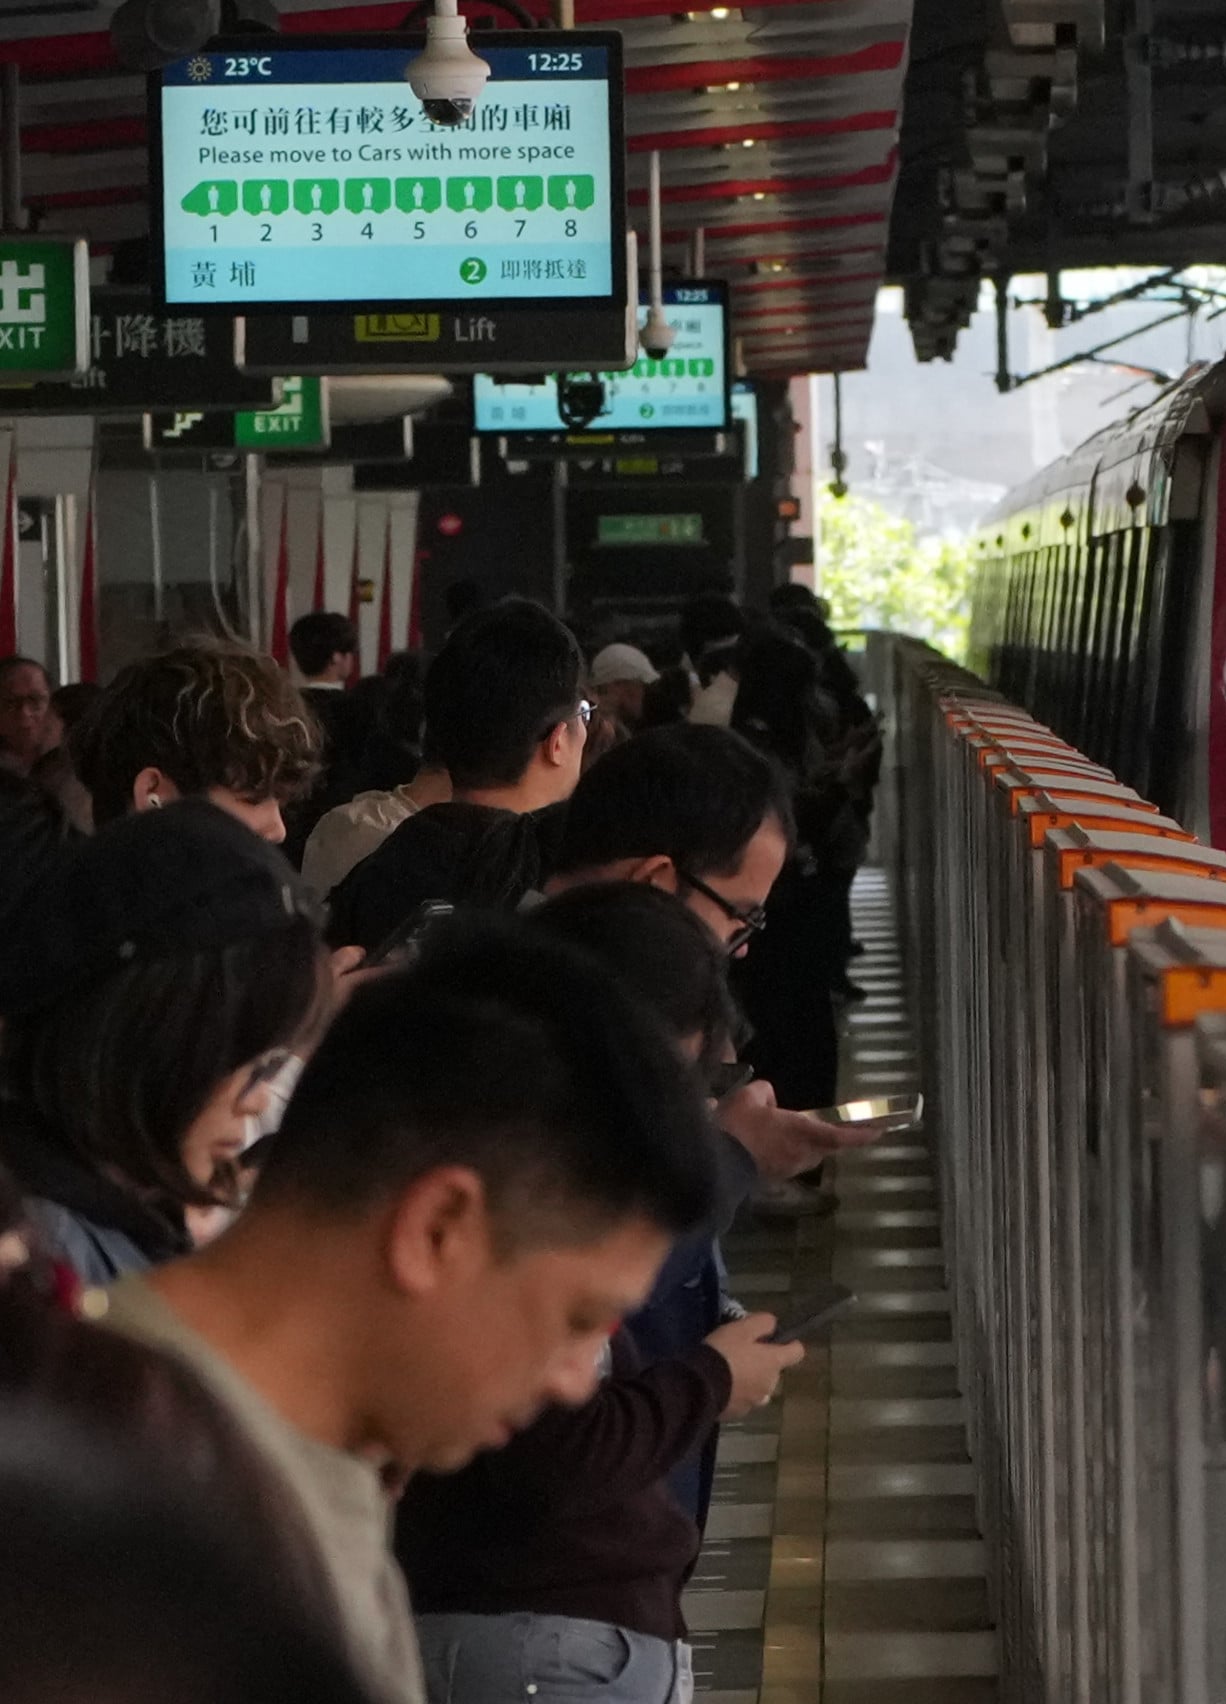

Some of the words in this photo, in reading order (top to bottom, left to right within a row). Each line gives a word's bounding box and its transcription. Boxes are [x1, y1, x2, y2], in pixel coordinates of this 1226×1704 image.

[225, 57, 272, 76] 23°C
[528, 53, 582, 72] 12:25
[199, 147, 263, 164] Please
[270, 150, 326, 163] move
[332, 148, 352, 162] to
[359, 144, 402, 161] Cars
[408, 144, 452, 160] with
[458, 146, 512, 160] more
[518, 146, 575, 163] space
[210, 225, 217, 242] 1
[261, 224, 272, 241] 2
[312, 223, 323, 241] 3
[361, 222, 374, 240] 4
[414, 221, 425, 239] 5
[464, 221, 477, 239] 6
[515, 220, 526, 238] 7
[565, 219, 577, 238] 8
[501, 258, 586, 280] 即將抵達
[455, 317, 497, 341] Lift
[254, 415, 302, 433] EXIT
